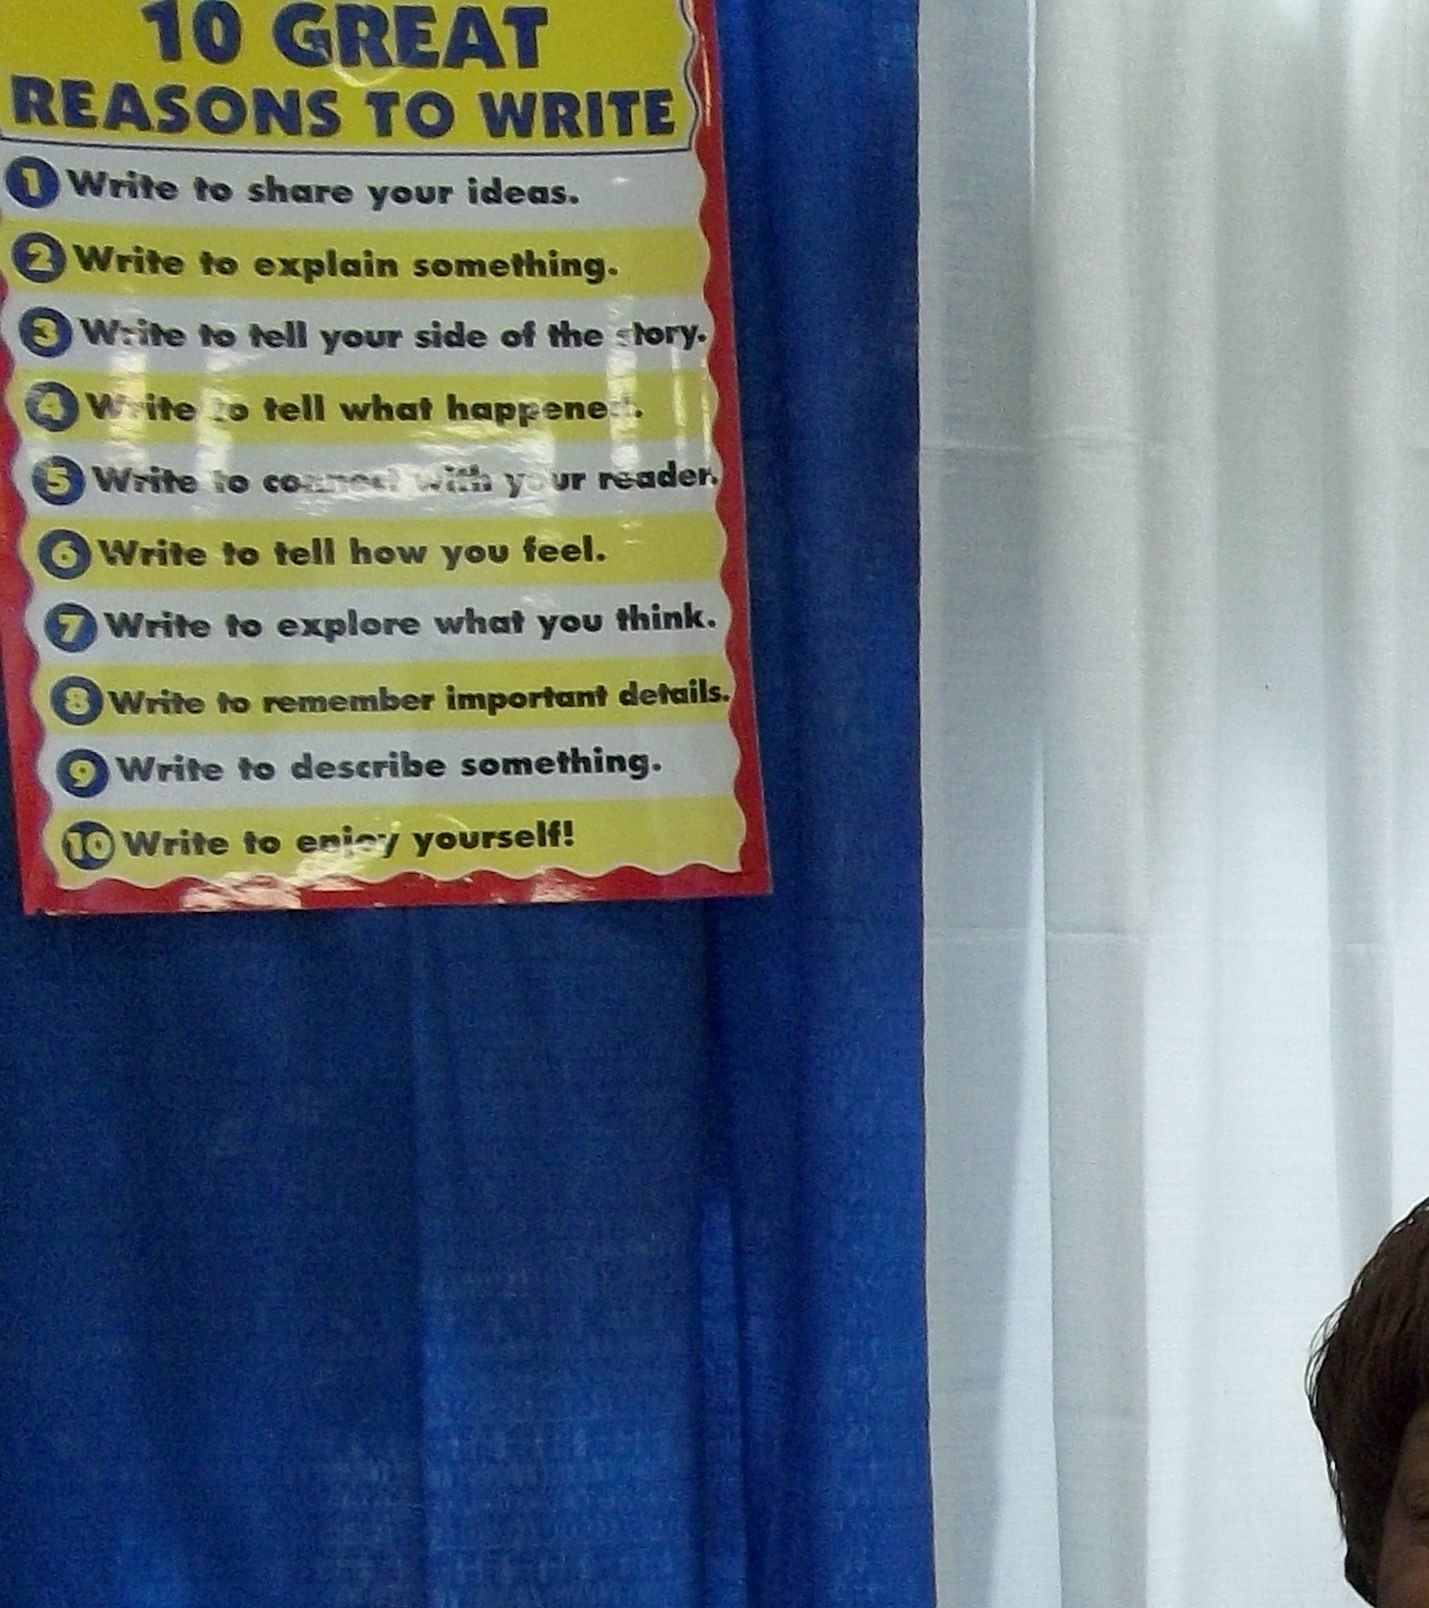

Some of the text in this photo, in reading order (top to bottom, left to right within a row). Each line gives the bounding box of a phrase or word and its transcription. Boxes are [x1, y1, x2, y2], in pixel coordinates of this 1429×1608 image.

[142, 0, 548, 69] 10 GREAT
[11, 75, 675, 139] REASONS TO WRITE
[23, 168, 578, 211] 1 Write to share your ideas.
[28, 243, 617, 284] 2 Write to explain something.
[59, 602, 715, 643] 7 Write to explore what you think.
[65, 678, 730, 715] 8 Write to remember important details.
[64, 828, 114, 862] 10
[122, 829, 229, 856] Write
[244, 831, 280, 854] to
[413, 820, 573, 857] yourself!
